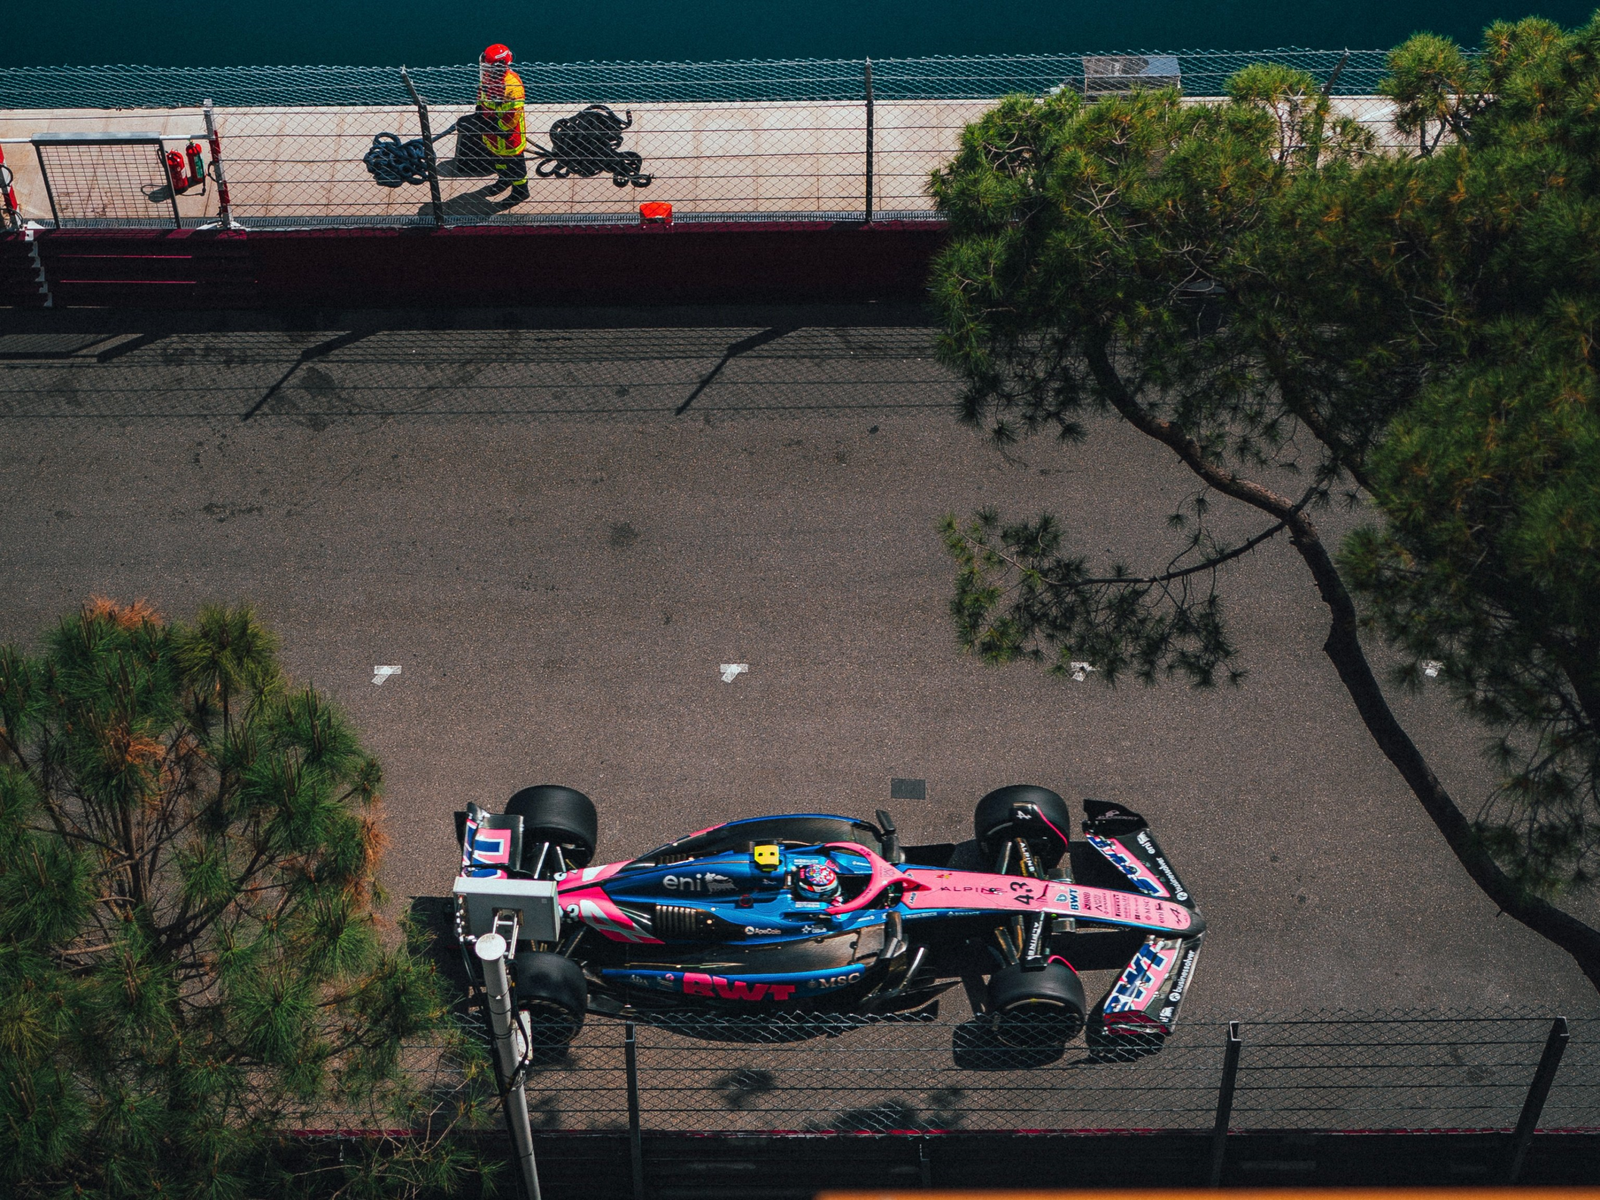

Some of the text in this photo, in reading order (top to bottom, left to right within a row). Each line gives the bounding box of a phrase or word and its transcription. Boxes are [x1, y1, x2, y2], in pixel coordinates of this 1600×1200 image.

[662, 873, 702, 891] eni
[1009, 881, 1034, 905] 43
[1068, 888, 1080, 911] BWT
[819, 972, 861, 989] MSC
[1174, 949, 1195, 993] businessolver
[683, 972, 796, 1000] BWT
